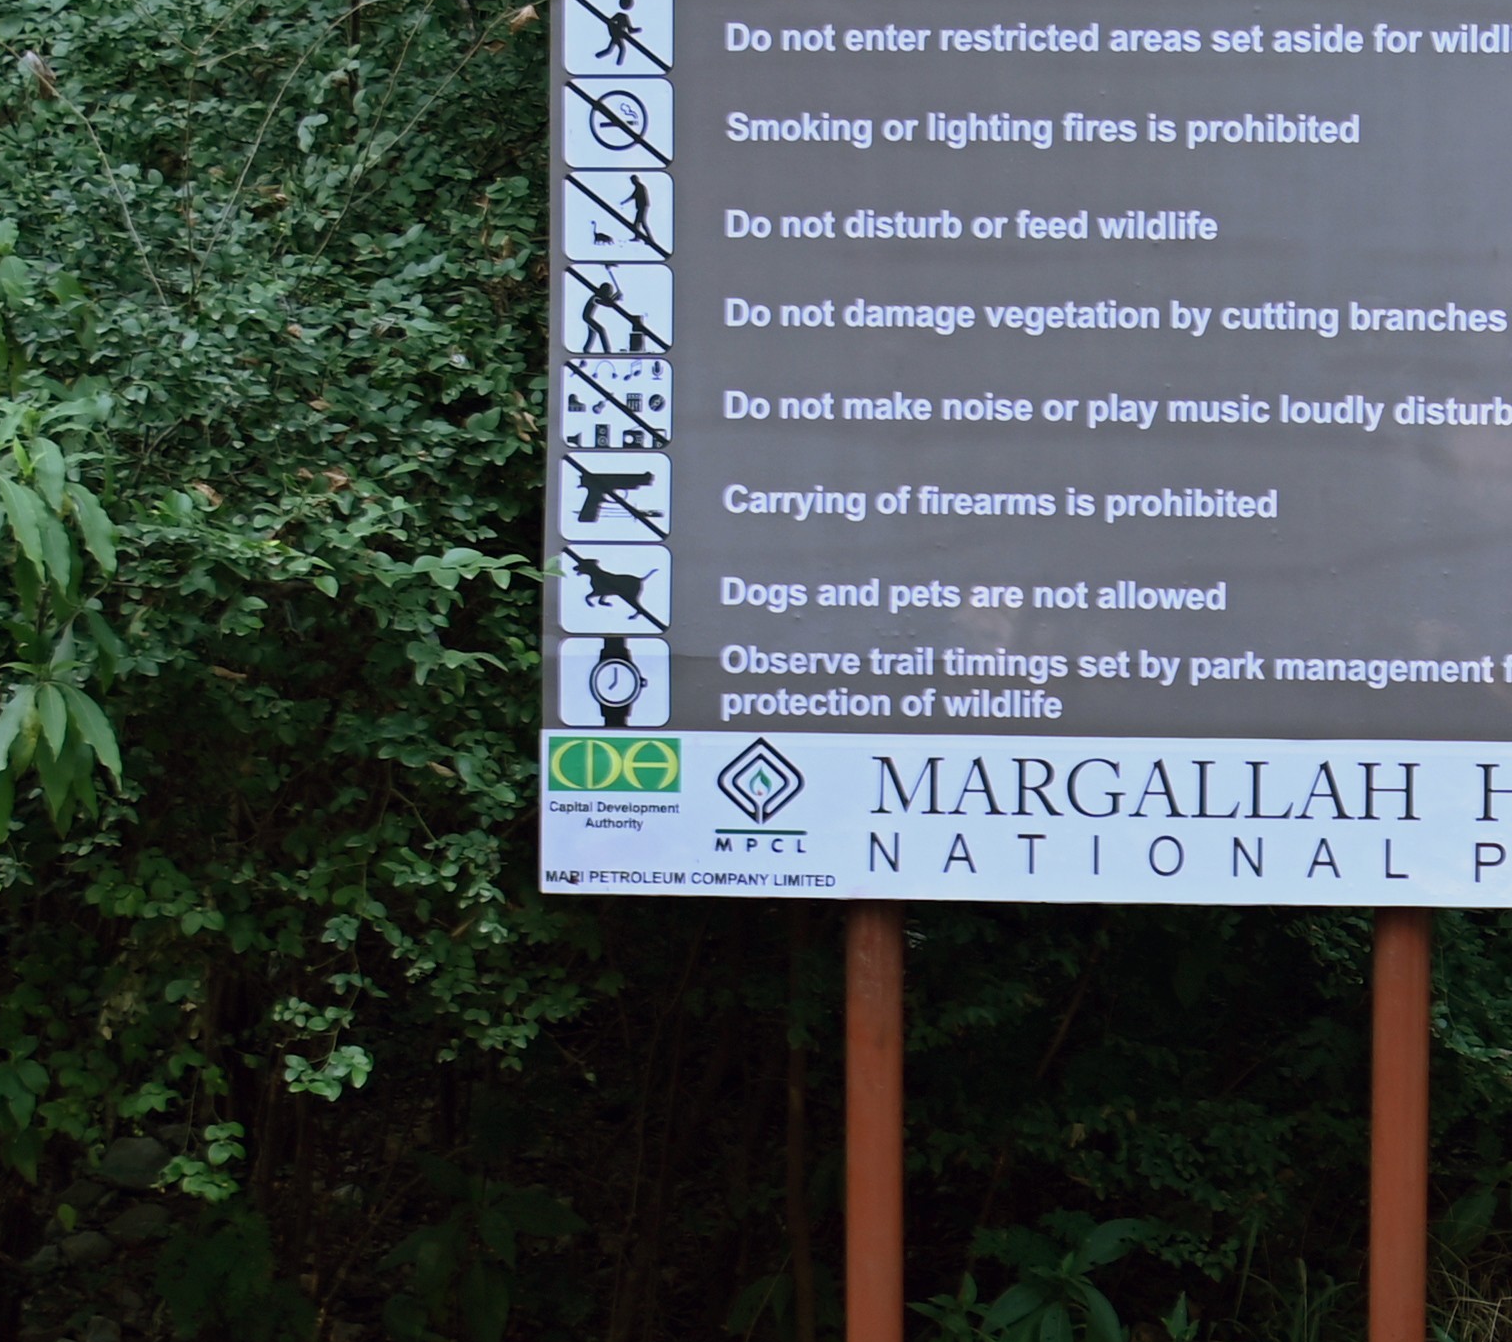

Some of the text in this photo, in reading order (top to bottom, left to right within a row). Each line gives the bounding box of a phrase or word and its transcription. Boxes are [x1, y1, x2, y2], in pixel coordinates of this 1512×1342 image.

[726, 111, 1360, 150] Smoking or lighting fires is prohibited
[723, 483, 1278, 524] Carrying of firearms is prohibited
[721, 686, 1063, 723] protection of wildlife
[869, 755, 1422, 822] MARGALLAH
[549, 800, 679, 816] Capital Development
[585, 817, 643, 832] Authority
[716, 838, 805, 854] MPCL
[869, 830, 1409, 880] NATIONAL
[590, 870, 685, 884] PETROLEUM
[692, 872, 767, 885] COMPANY
[774, 874, 835, 887] LIMITED
